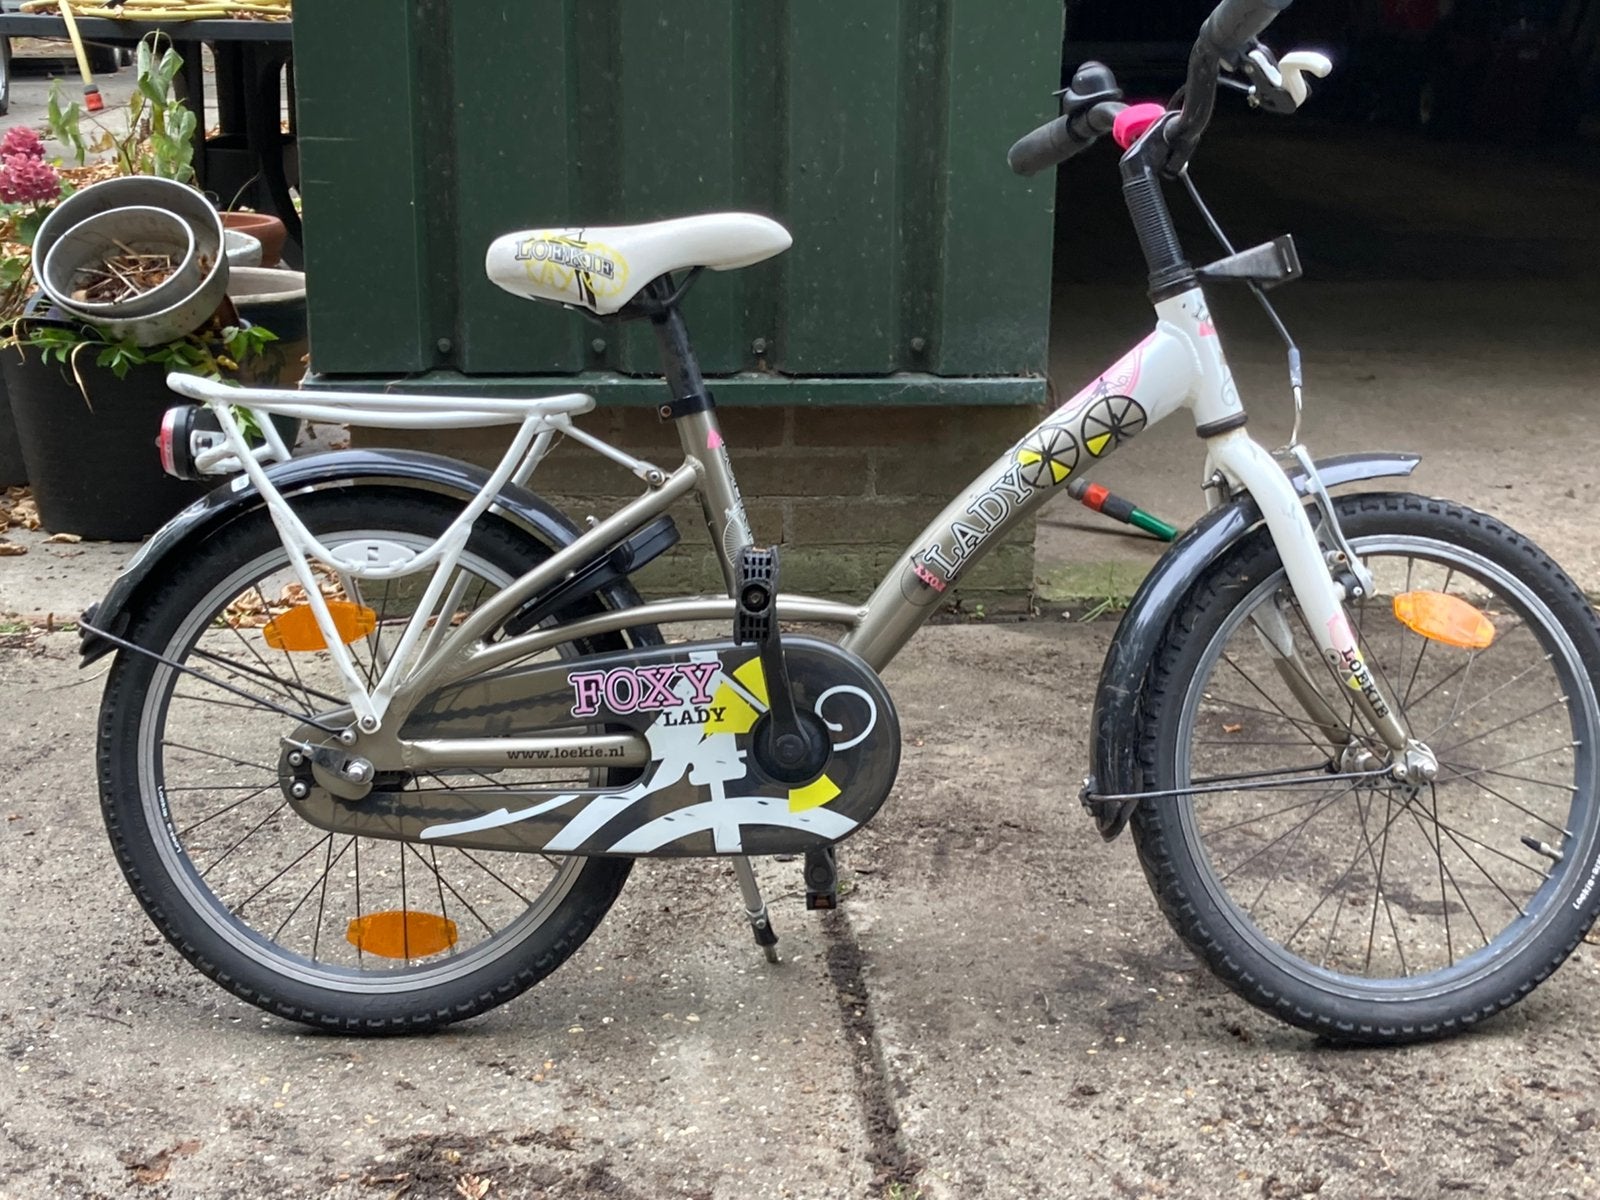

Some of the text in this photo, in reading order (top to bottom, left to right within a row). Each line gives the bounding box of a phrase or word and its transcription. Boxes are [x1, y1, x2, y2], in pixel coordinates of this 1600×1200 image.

[515, 239, 614, 279] LOEKIE
[924, 463, 1033, 579] LADY
[568, 660, 723, 717] FOXY
[1341, 647, 1389, 718] LOEKIE
[663, 707, 726, 727] LADY
[506, 745, 625, 760] www.loekie.nl
